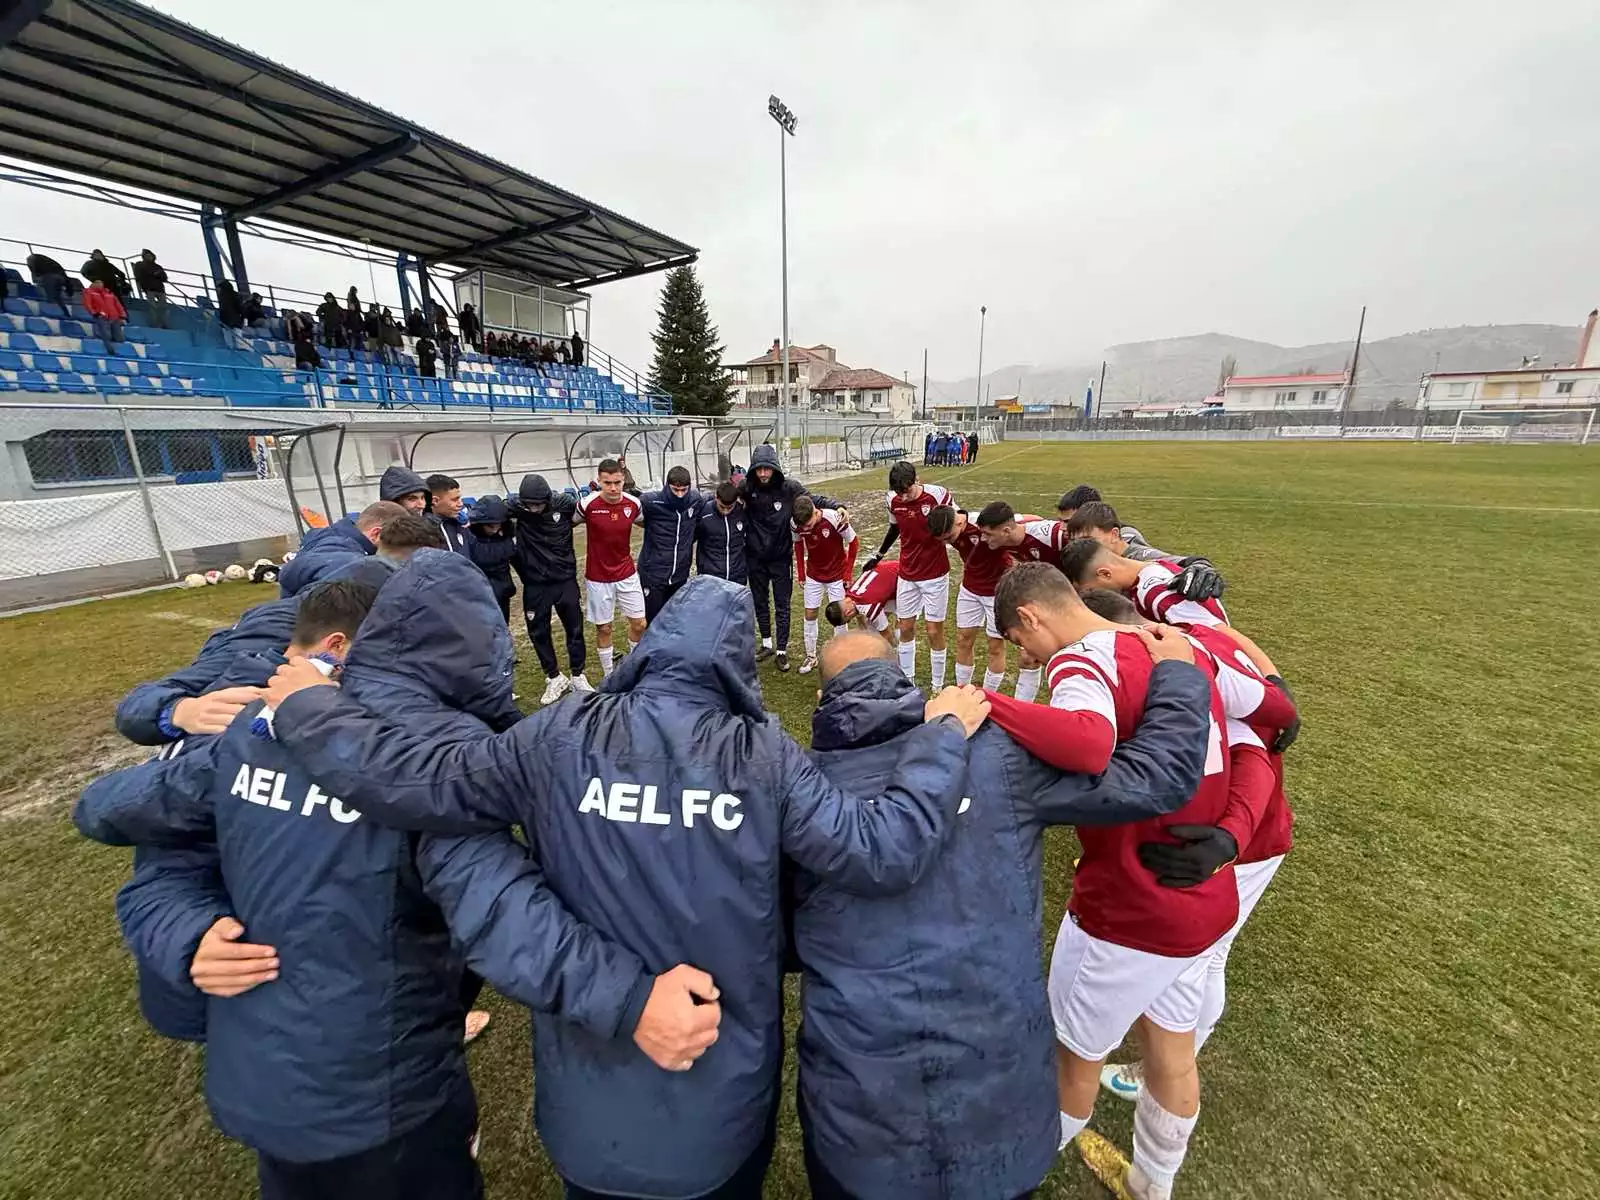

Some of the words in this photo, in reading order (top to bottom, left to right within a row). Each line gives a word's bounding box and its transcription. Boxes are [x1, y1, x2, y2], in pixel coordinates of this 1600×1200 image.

[230, 763, 292, 811] AEL
[578, 777, 672, 825] AEL
[682, 789, 744, 831] FC
